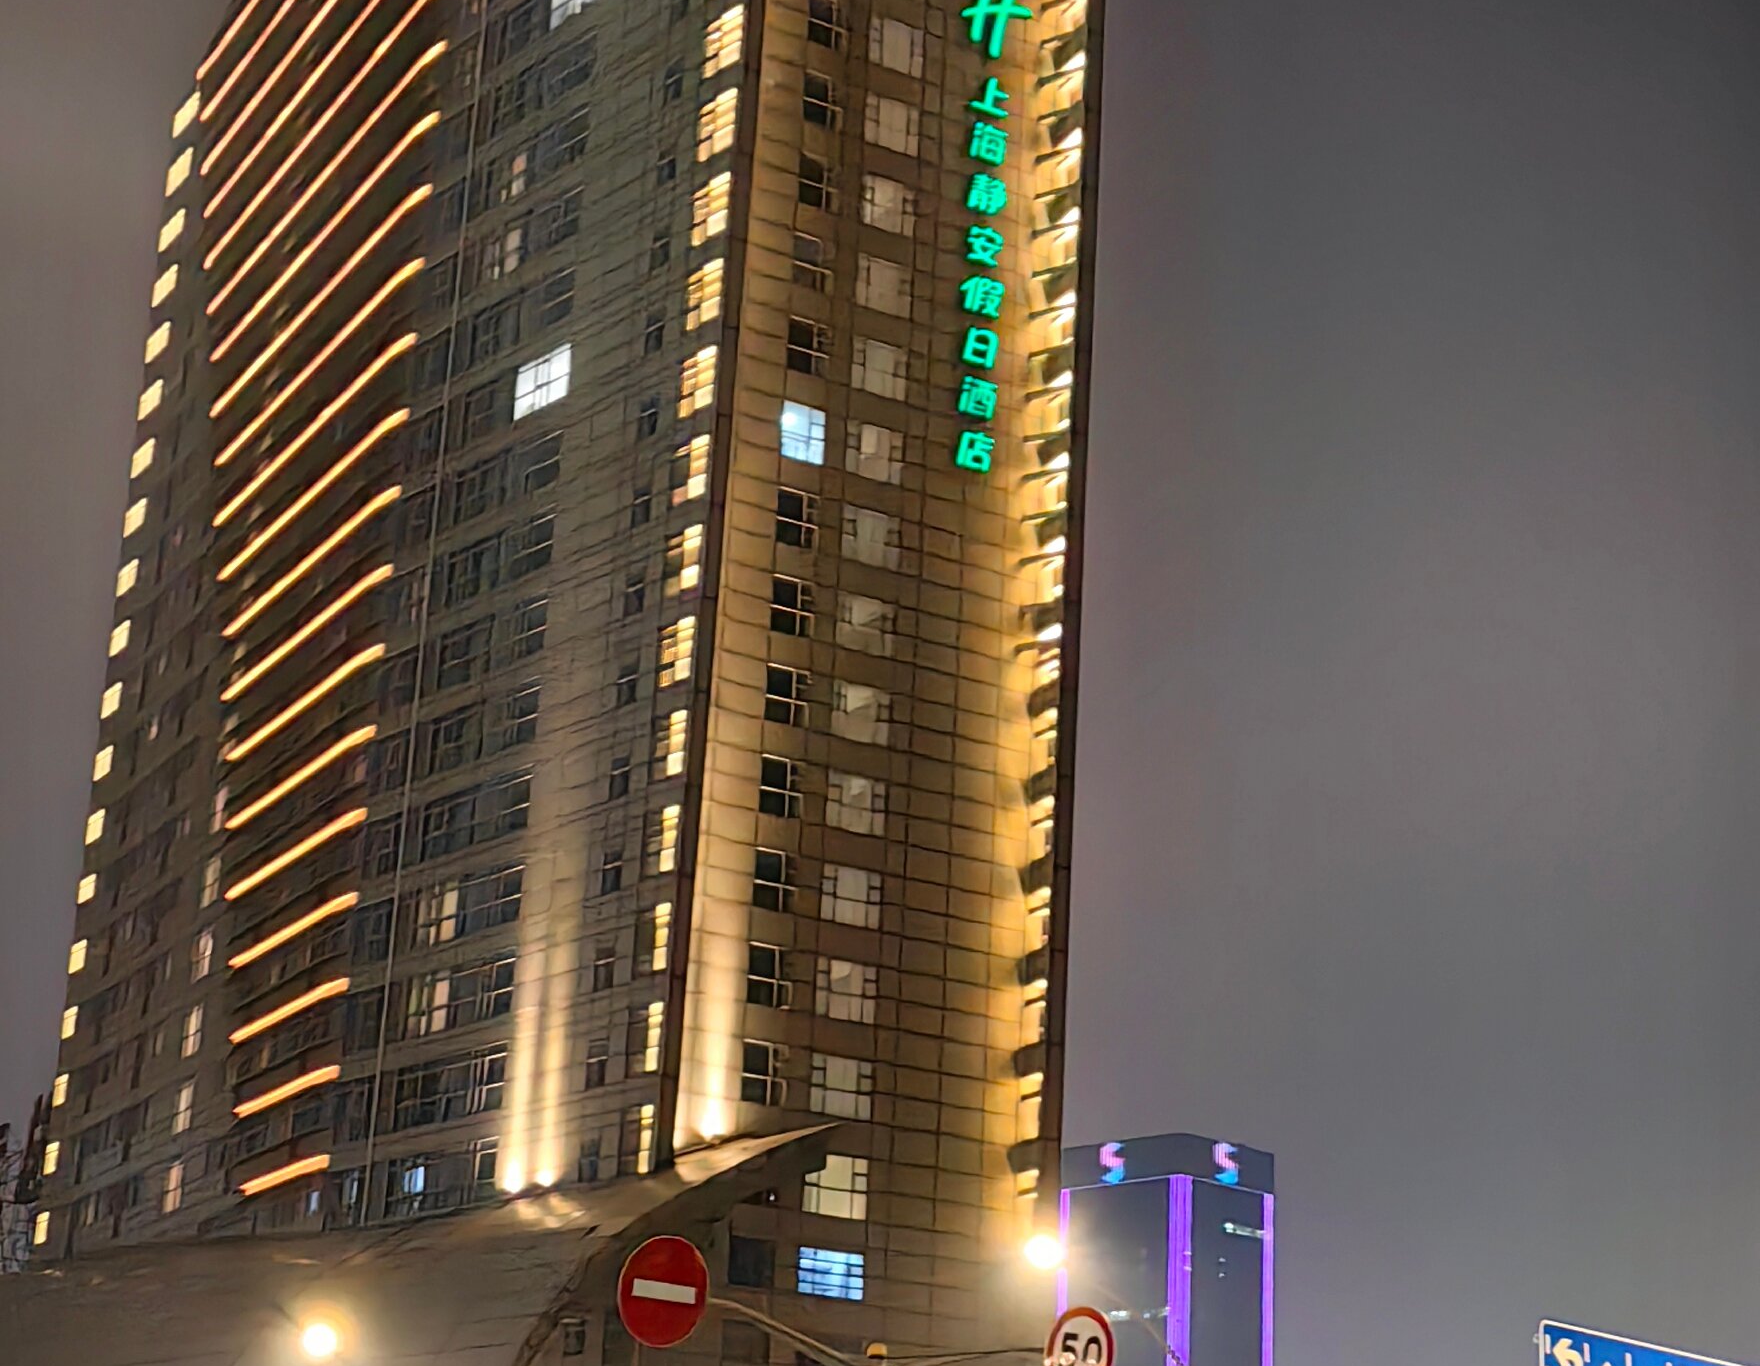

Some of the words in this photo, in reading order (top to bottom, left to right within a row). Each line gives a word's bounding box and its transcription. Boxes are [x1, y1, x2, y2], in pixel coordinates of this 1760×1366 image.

[955, 77, 1008, 473] 上海静安假日酒店
